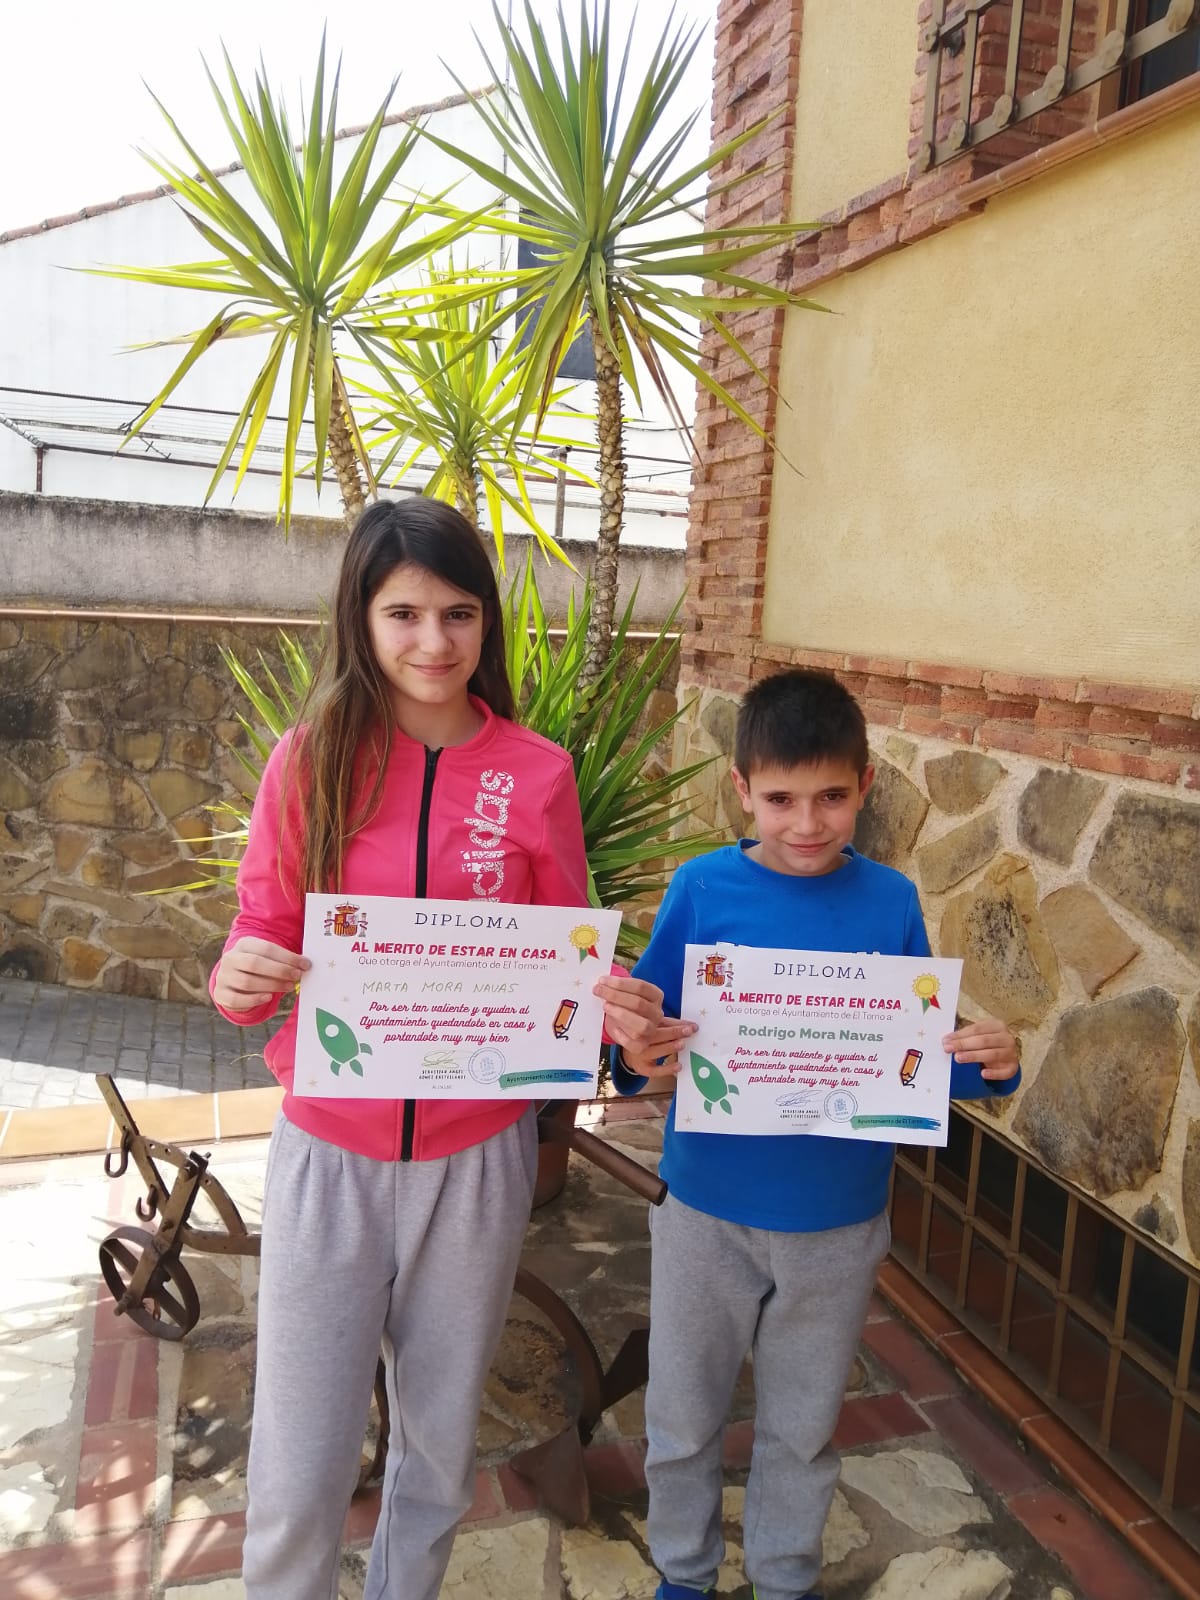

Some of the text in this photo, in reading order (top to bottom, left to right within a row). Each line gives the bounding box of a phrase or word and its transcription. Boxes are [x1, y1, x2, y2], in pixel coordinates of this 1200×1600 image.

[460, 769, 514, 902] didas
[414, 912, 519, 930] DIPLOMA
[351, 942, 557, 960] AL MERITO DE ESTAR EN CASA
[358, 956, 378, 966] Que
[379, 957, 411, 968] otorga
[412, 957, 422, 967] el
[423, 957, 488, 969] Ayuntamiento
[489, 960, 501, 969] de
[503, 961, 512, 970] El
[513, 961, 539, 970] Torno
[774, 962, 867, 980] DIPLOMA
[362, 981, 519, 995] MARTA MORA NAVAS
[719, 991, 902, 1010] AL MERITO DE ESTAR EN CASA
[369, 1001, 530, 1018] Por ser tan valiente y ayudar al
[725, 1006, 742, 1015] Que
[744, 1007, 771, 1018] otorga
[772, 1008, 780, 1016] el
[782, 1008, 839, 1019] Ayuntamiento
[841, 1010, 851, 1019] de
[853, 1011, 861, 1020] El
[862, 1012, 885, 1021] Torno
[359, 1016, 536, 1032] Ayuntamiento quedandote en casa y
[383, 1031, 511, 1046] portandote muy muy bien
[738, 1024, 884, 1043] Rodrigo Mora Navas
[735, 1047, 752, 1056] Por
[771, 1049, 787, 1058] tan
[788, 1049, 823, 1061] valiente
[823, 1053, 832, 1062] y
[834, 1052, 866, 1064] ayudar
[868, 1053, 878, 1062] al
[727, 1060, 787, 1072] Ayuntamiento
[788, 1064, 837, 1075] quedandote
[854, 1066, 875, 1075] casa
[875, 1068, 884, 1078] y
[748, 1074, 860, 1089] portandote muy muy bien
